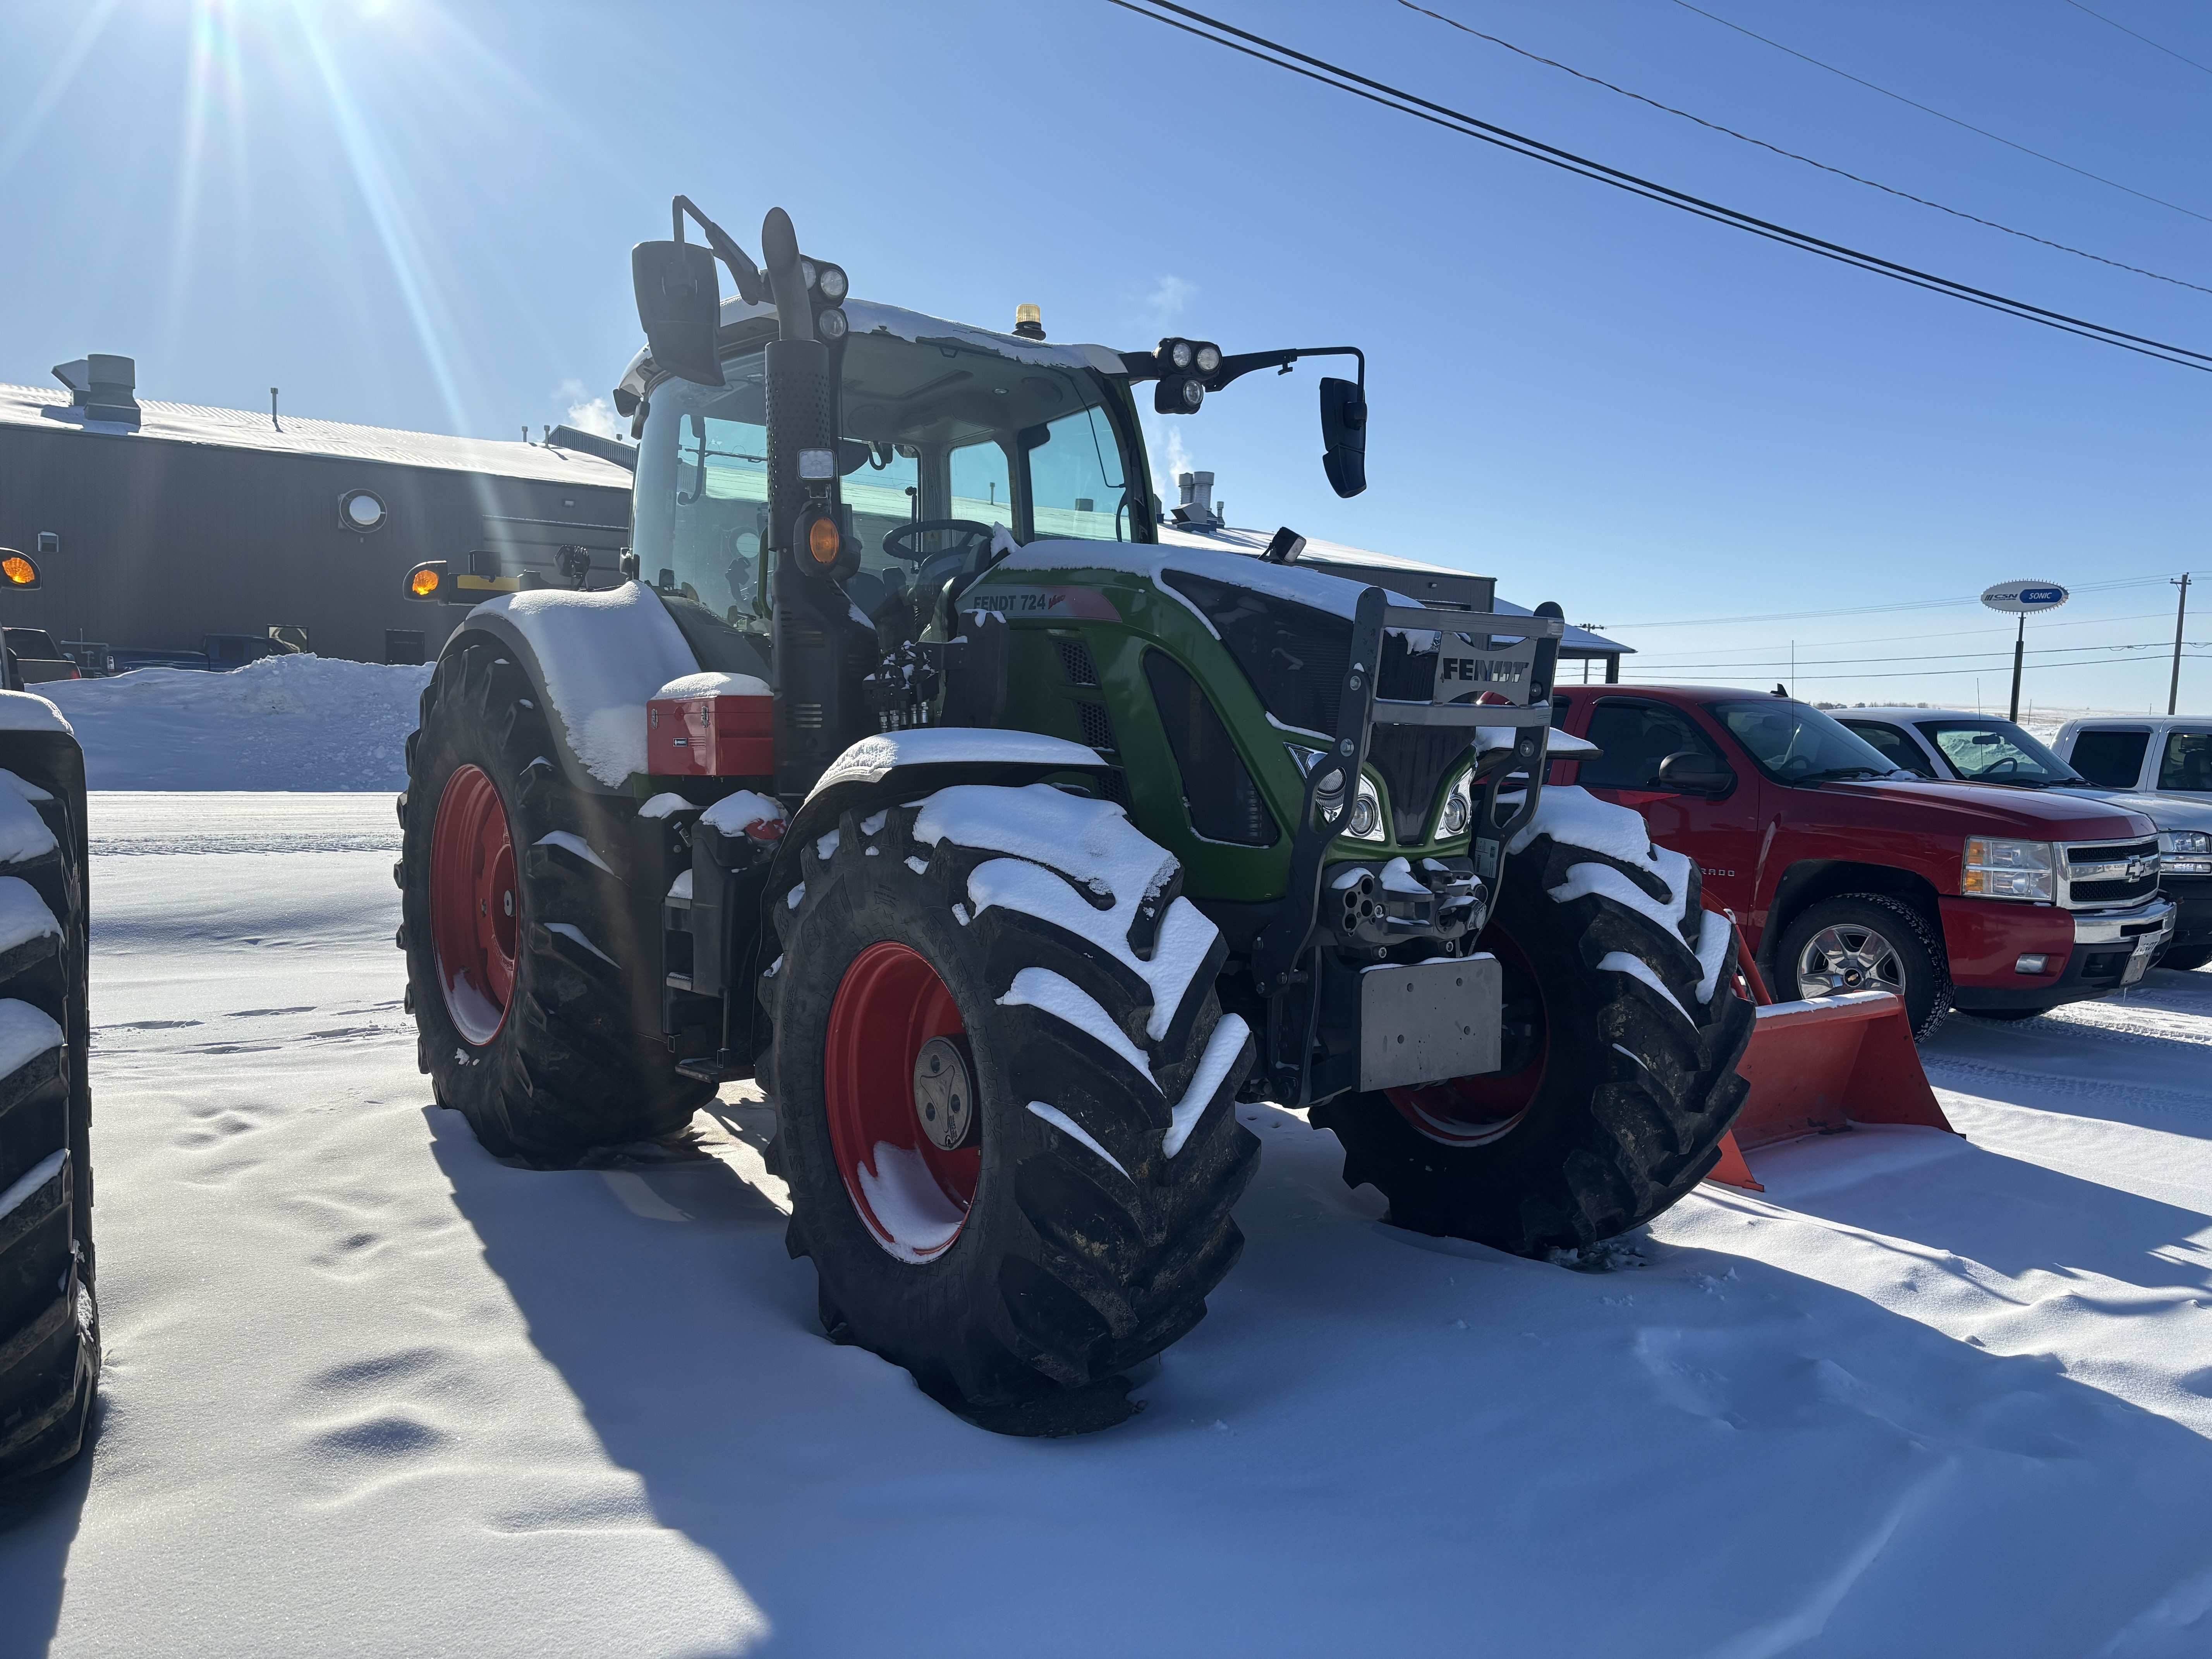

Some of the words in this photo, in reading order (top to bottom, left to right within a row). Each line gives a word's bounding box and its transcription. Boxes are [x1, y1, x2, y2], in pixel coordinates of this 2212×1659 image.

[974, 595, 1016, 611] FENDT
[1021, 594, 1046, 610] 724
[1443, 658, 1529, 683] FENDT
